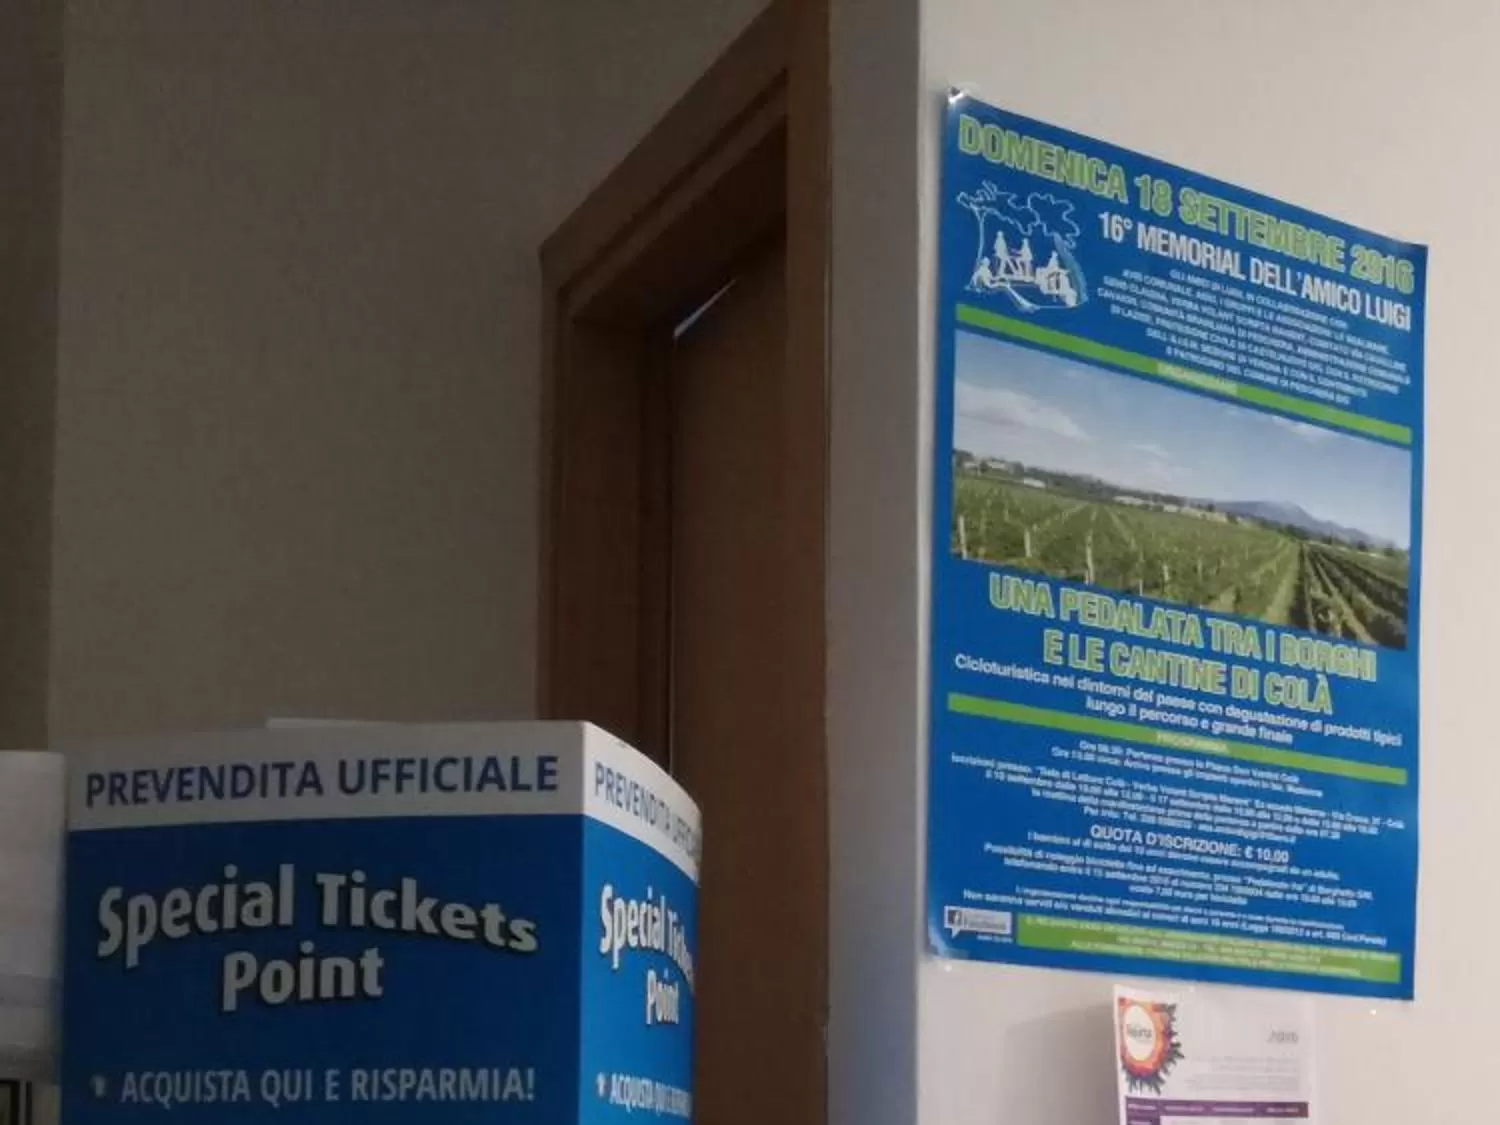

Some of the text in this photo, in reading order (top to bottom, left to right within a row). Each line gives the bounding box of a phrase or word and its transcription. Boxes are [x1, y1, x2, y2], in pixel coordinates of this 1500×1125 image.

[959, 114, 1415, 295] DOMENICA 18 SETTEMBRE 2016
[1137, 225, 1246, 280] MEMORIAL
[1250, 261, 1361, 316] DELL'AMICO
[1365, 297, 1412, 331] LUIGI
[989, 573, 1378, 682] UNA PEDALATA TRA I BORGHI
[955, 653, 1050, 686] Cicloturistica
[1077, 676, 1131, 700] dintorni
[1043, 630, 1334, 715] E LE CANTINE DI COLÀ
[1086, 696, 1127, 720] lungo
[85, 754, 560, 809] PREVENDITA UFFICIALE
[1090, 823, 1144, 847] QUOTA
[98, 863, 539, 968] Special Tickets
[599, 883, 665, 970] Special
[220, 942, 385, 1012] Point
[121, 1067, 536, 1109] ACQUISTA QUI E RISPARMIA!
